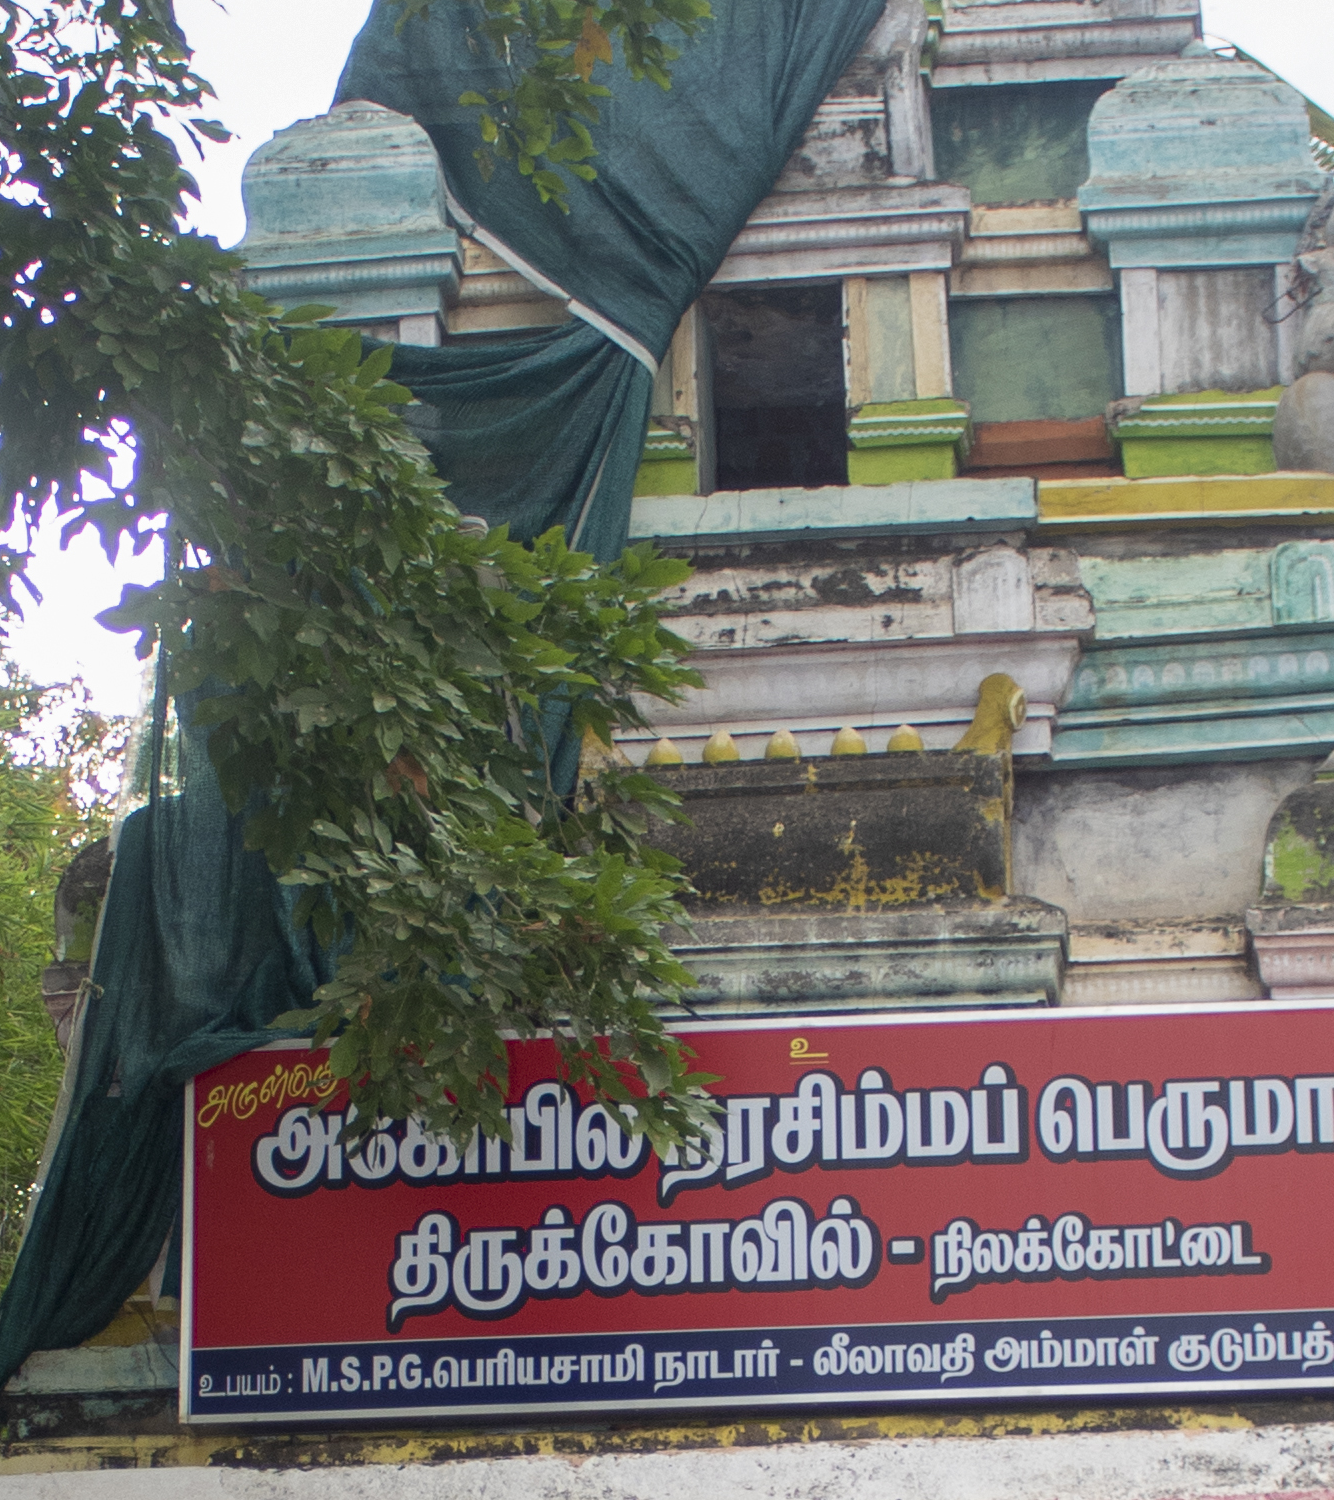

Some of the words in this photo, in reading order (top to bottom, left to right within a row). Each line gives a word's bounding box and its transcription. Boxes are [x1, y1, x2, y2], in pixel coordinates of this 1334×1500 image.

[390, 1198, 874, 1323] திருக்கோவில்
[933, 1214, 1263, 1294] நிலக்கோட்டை
[653, 1338, 781, 1394] நாடார்
[812, 1332, 976, 1384] லீலாவதி
[983, 1325, 1160, 1373] அம்மாள்
